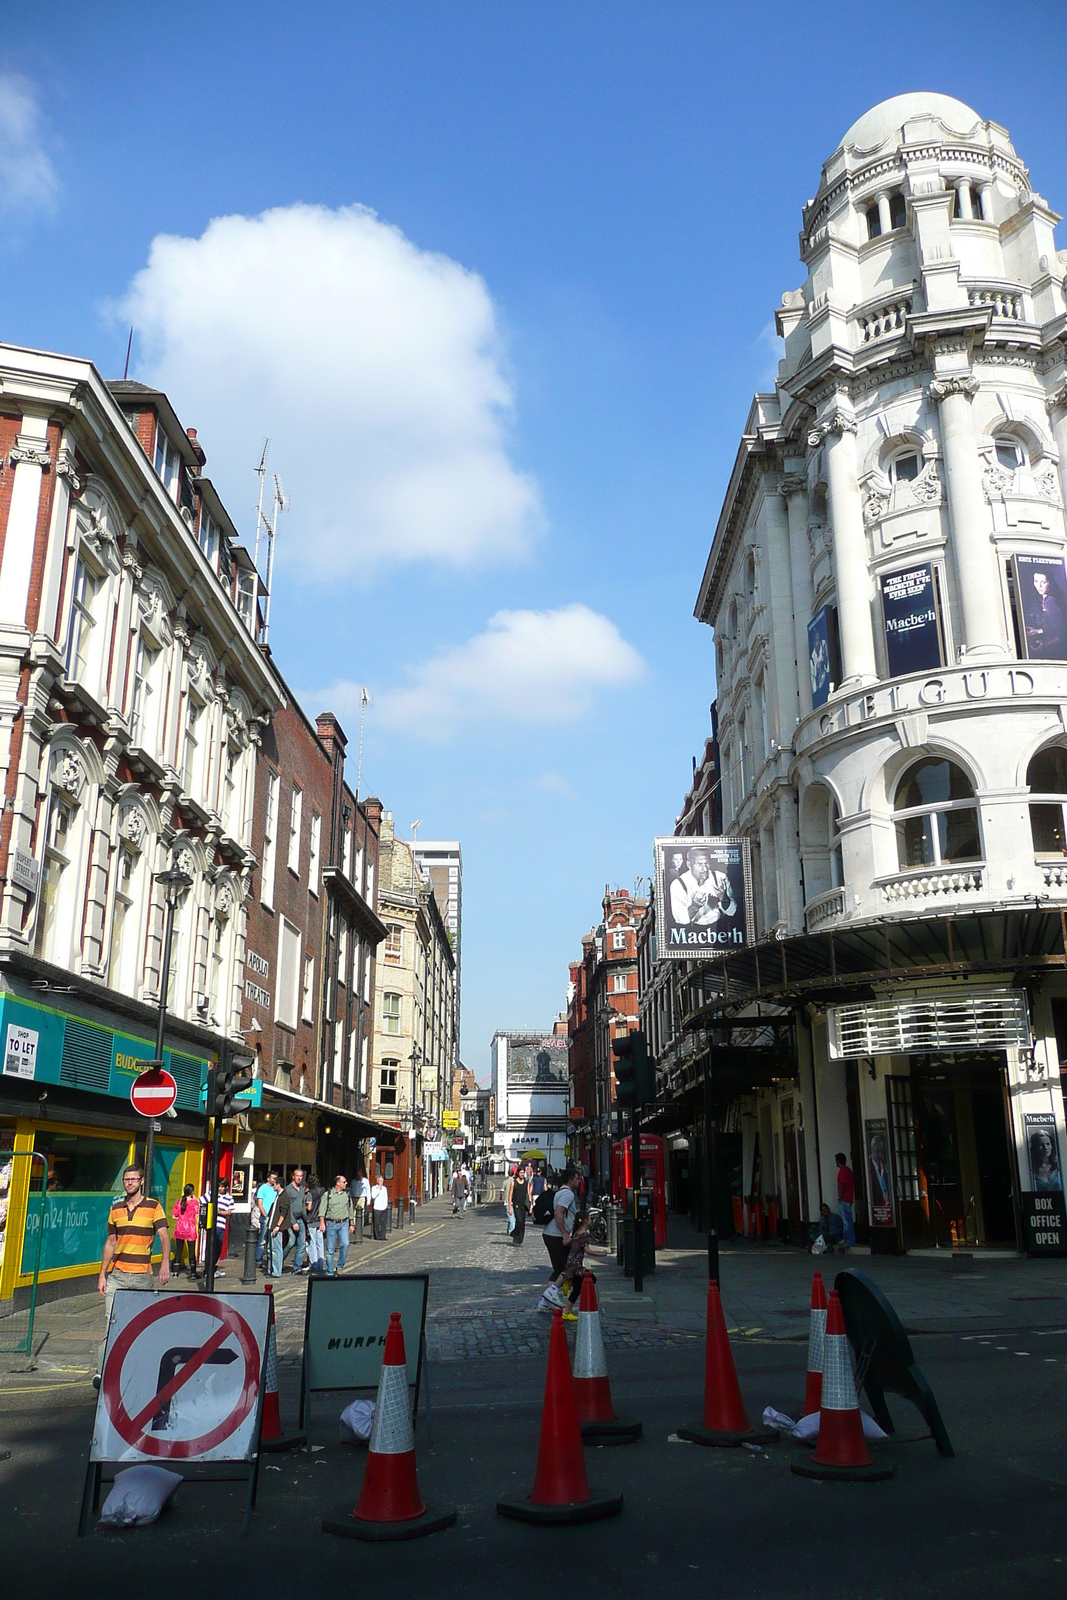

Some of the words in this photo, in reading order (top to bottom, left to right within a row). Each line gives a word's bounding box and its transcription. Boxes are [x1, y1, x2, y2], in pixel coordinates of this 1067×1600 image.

[888, 589, 907, 599] EVER
[886, 610, 936, 632] Macbeth
[818, 670, 1034, 737] GIELGUD
[15, 862, 31, 878] STREET
[669, 927, 744, 946] Macbeth
[248, 952, 268, 977] APOLLO
[247, 982, 270, 1008] THEATRE
[17, 1030, 29, 1039] SHOP
[10, 1038, 20, 1051] TO
[22, 1041, 35, 1055] LET
[115, 1052, 154, 1073] BUDGE
[1034, 1198, 1053, 1210] BOX
[26, 1212, 50, 1235] opn
[51, 1207, 63, 1229] 24
[65, 1206, 89, 1228] hours
[1030, 1215, 1061, 1228] OFFICE
[1035, 1232, 1060, 1245] OPEN
[327, 1335, 387, 1350] MURPH
